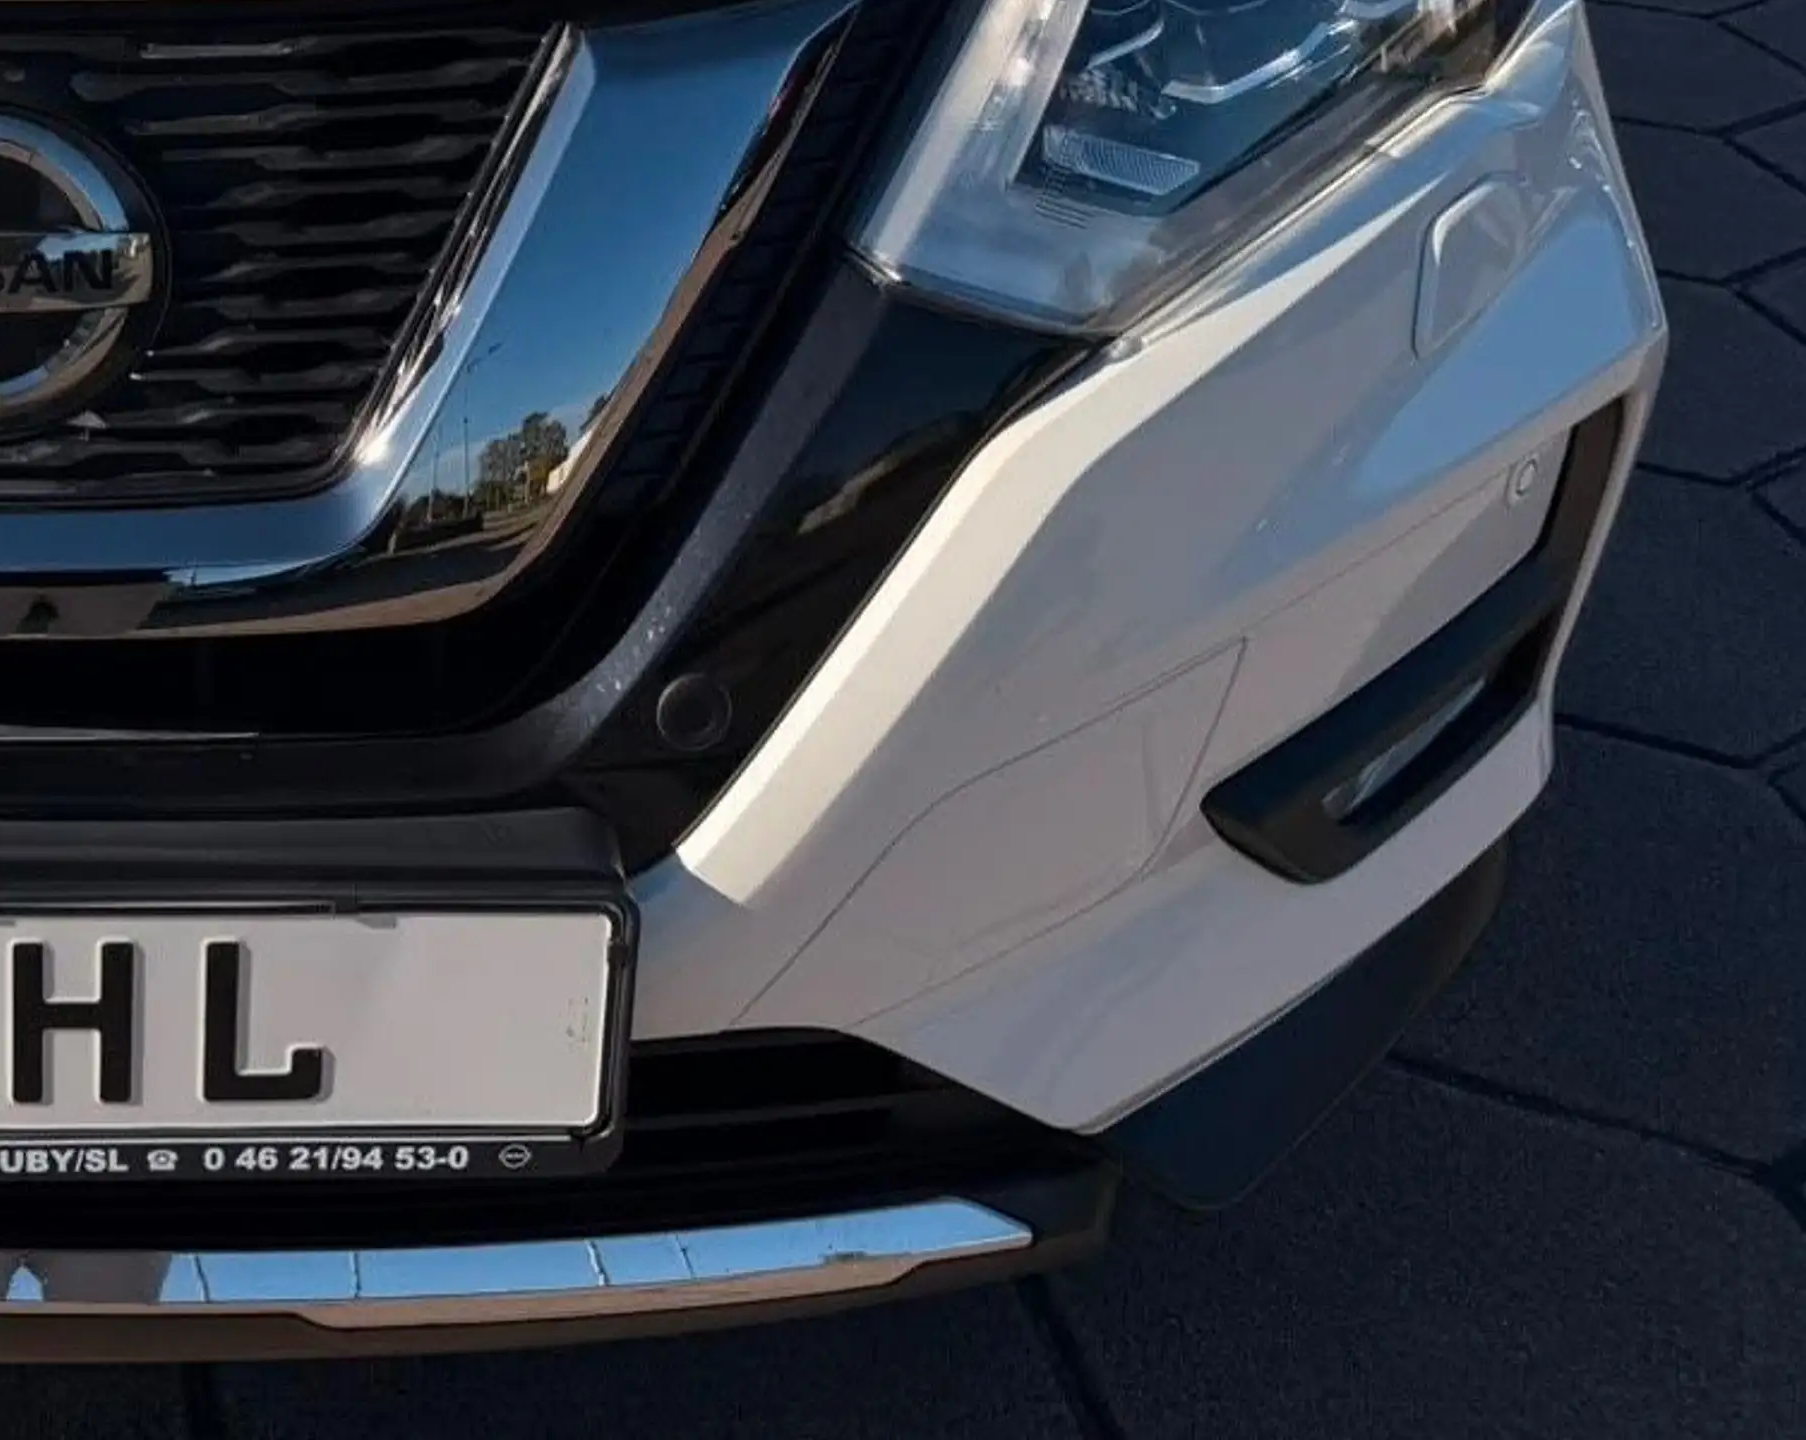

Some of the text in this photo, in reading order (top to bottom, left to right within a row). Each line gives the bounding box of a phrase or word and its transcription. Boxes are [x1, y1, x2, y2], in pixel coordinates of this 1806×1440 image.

[202, 1146, 226, 1172] 0
[234, 1145, 280, 1172] 46
[288, 1145, 385, 1171] 21/94
[393, 1144, 470, 1171] 53-0
